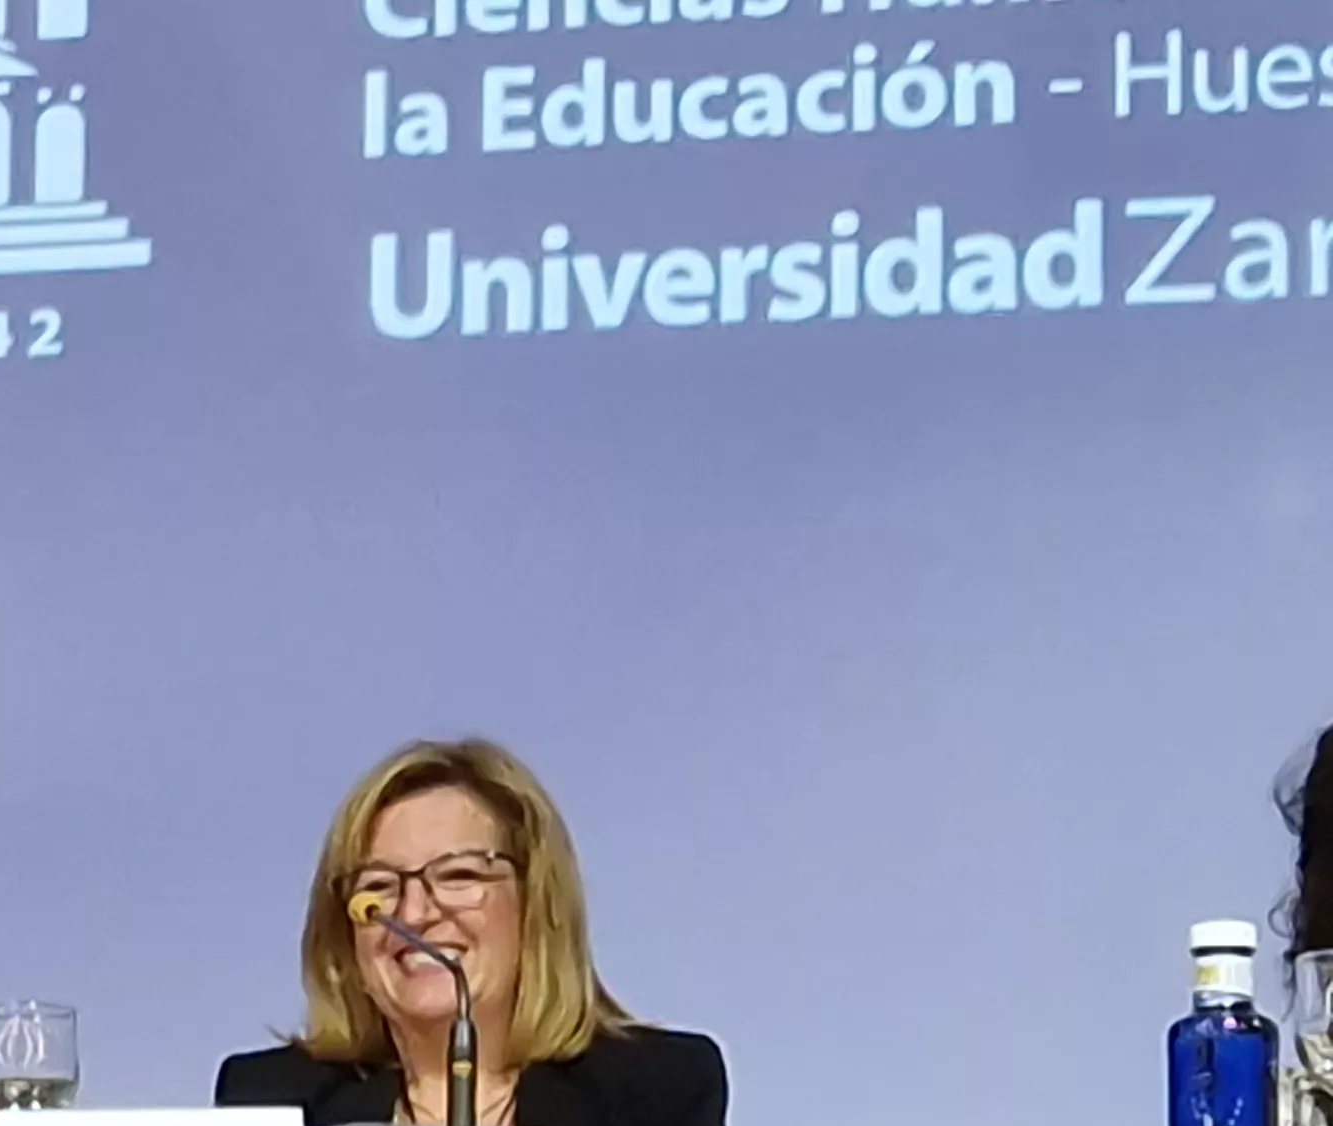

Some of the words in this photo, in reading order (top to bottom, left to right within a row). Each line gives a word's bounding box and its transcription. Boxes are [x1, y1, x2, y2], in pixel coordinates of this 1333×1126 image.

[364, 69, 448, 159] la
[482, 40, 1016, 152] Educación
[369, 197, 1104, 339] Universidad
